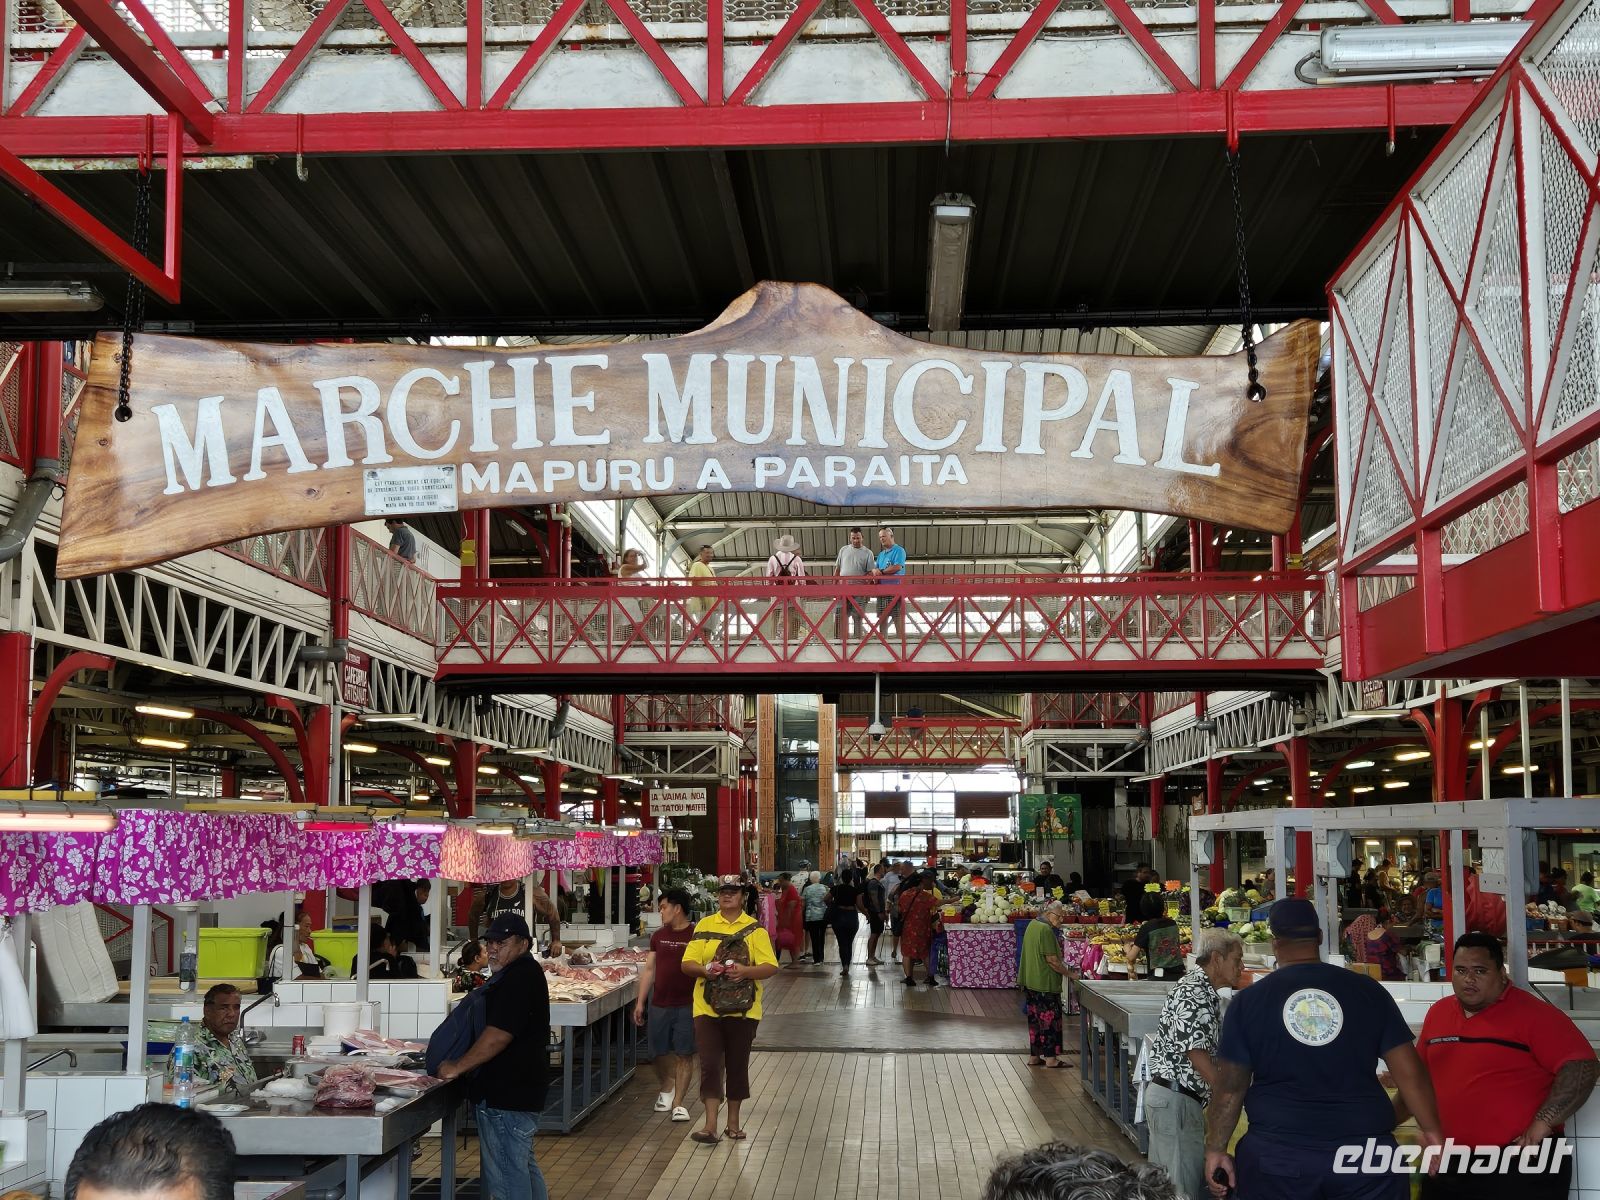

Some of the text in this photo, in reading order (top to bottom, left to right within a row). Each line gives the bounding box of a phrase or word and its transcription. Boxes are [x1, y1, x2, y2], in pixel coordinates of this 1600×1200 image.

[151, 353, 1221, 494] MARCHE MUNICIPAL
[461, 454, 969, 494] MAPURU A PARAITA
[662, 804, 684, 812] TATOU
